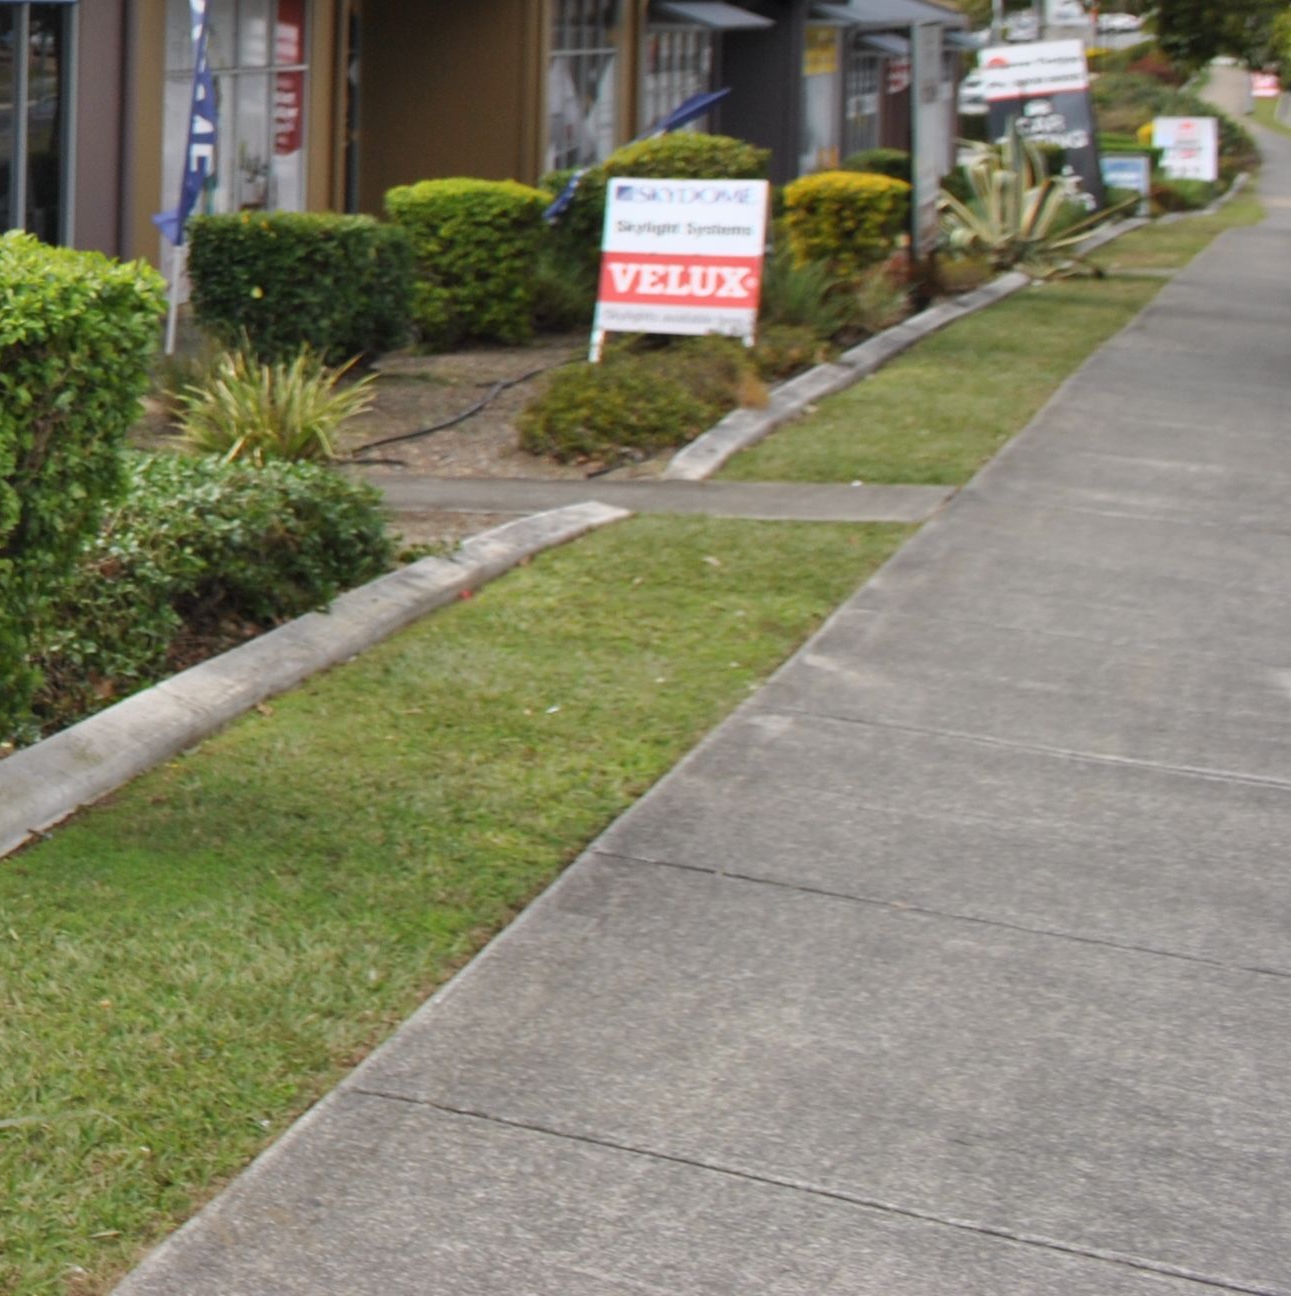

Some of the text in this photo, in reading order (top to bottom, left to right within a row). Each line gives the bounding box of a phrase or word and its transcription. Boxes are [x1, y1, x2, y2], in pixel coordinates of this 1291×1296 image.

[638, 185, 753, 204] SKYDOME
[617, 219, 753, 238] Skylight Systems
[607, 262, 752, 299] VELUX
